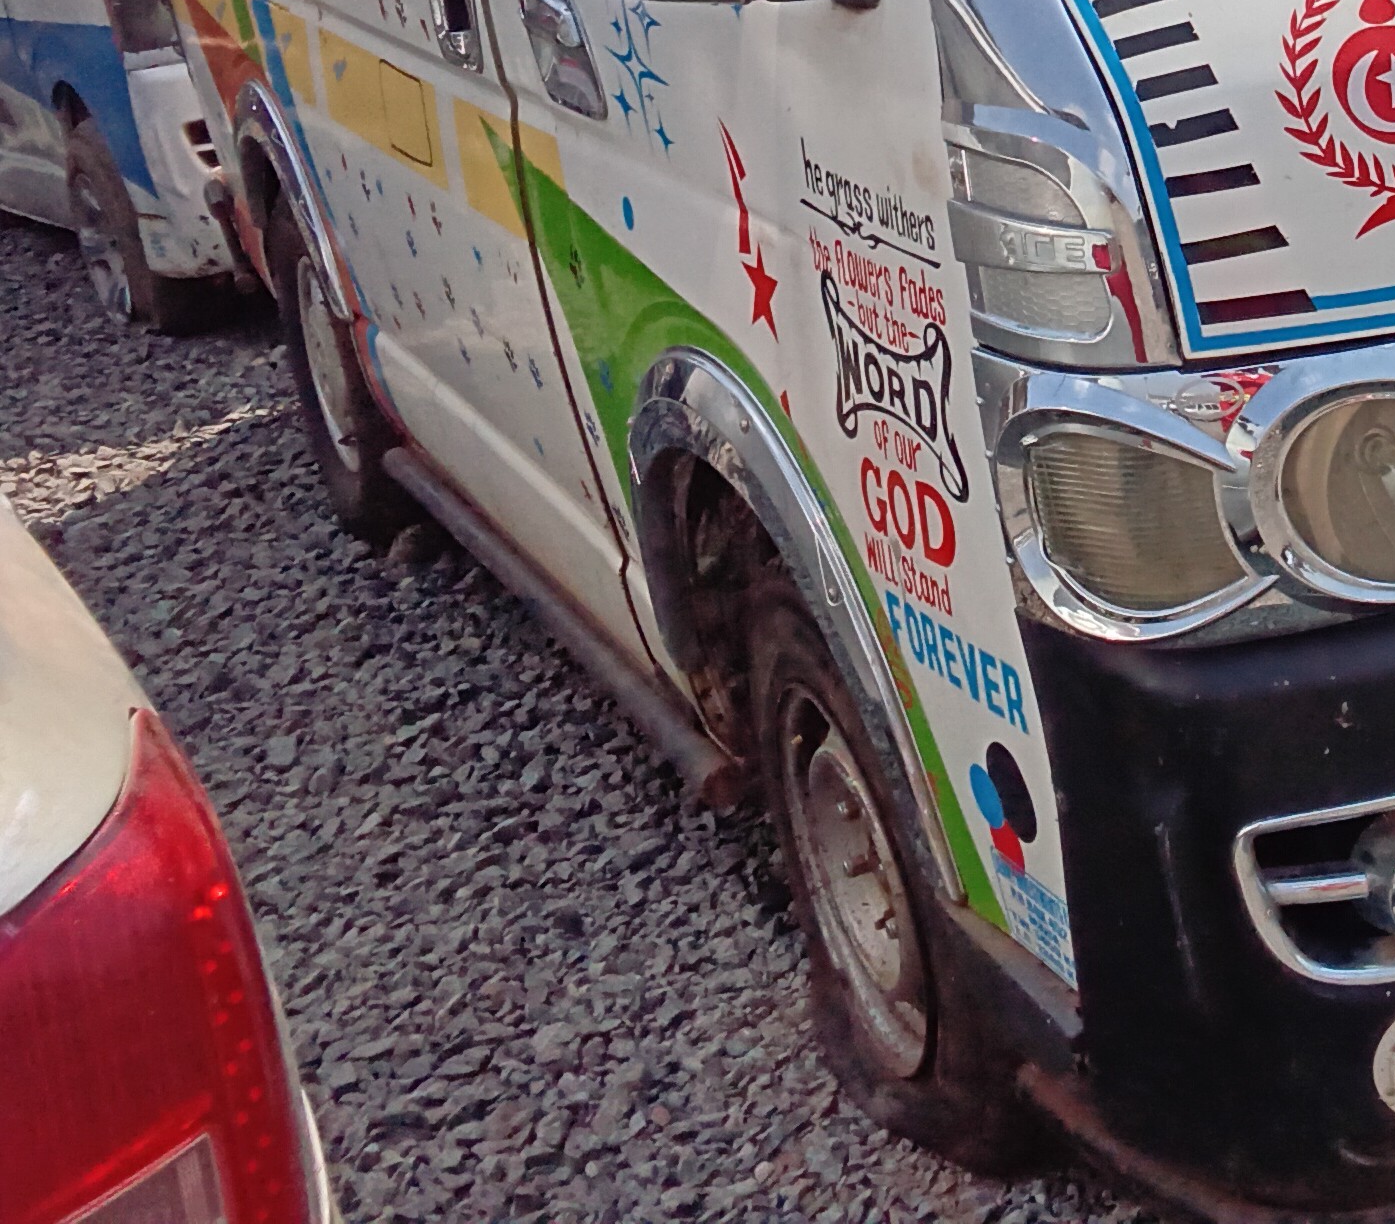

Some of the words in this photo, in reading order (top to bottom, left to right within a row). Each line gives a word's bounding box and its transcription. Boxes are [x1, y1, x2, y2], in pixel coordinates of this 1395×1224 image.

[809, 225, 833, 274] the
[826, 170, 874, 223] grass
[876, 186, 936, 251] withers
[836, 316, 938, 442] WORD
[894, 431, 922, 472] our
[861, 457, 956, 568] GOD
[885, 589, 1030, 736] FOREVER
